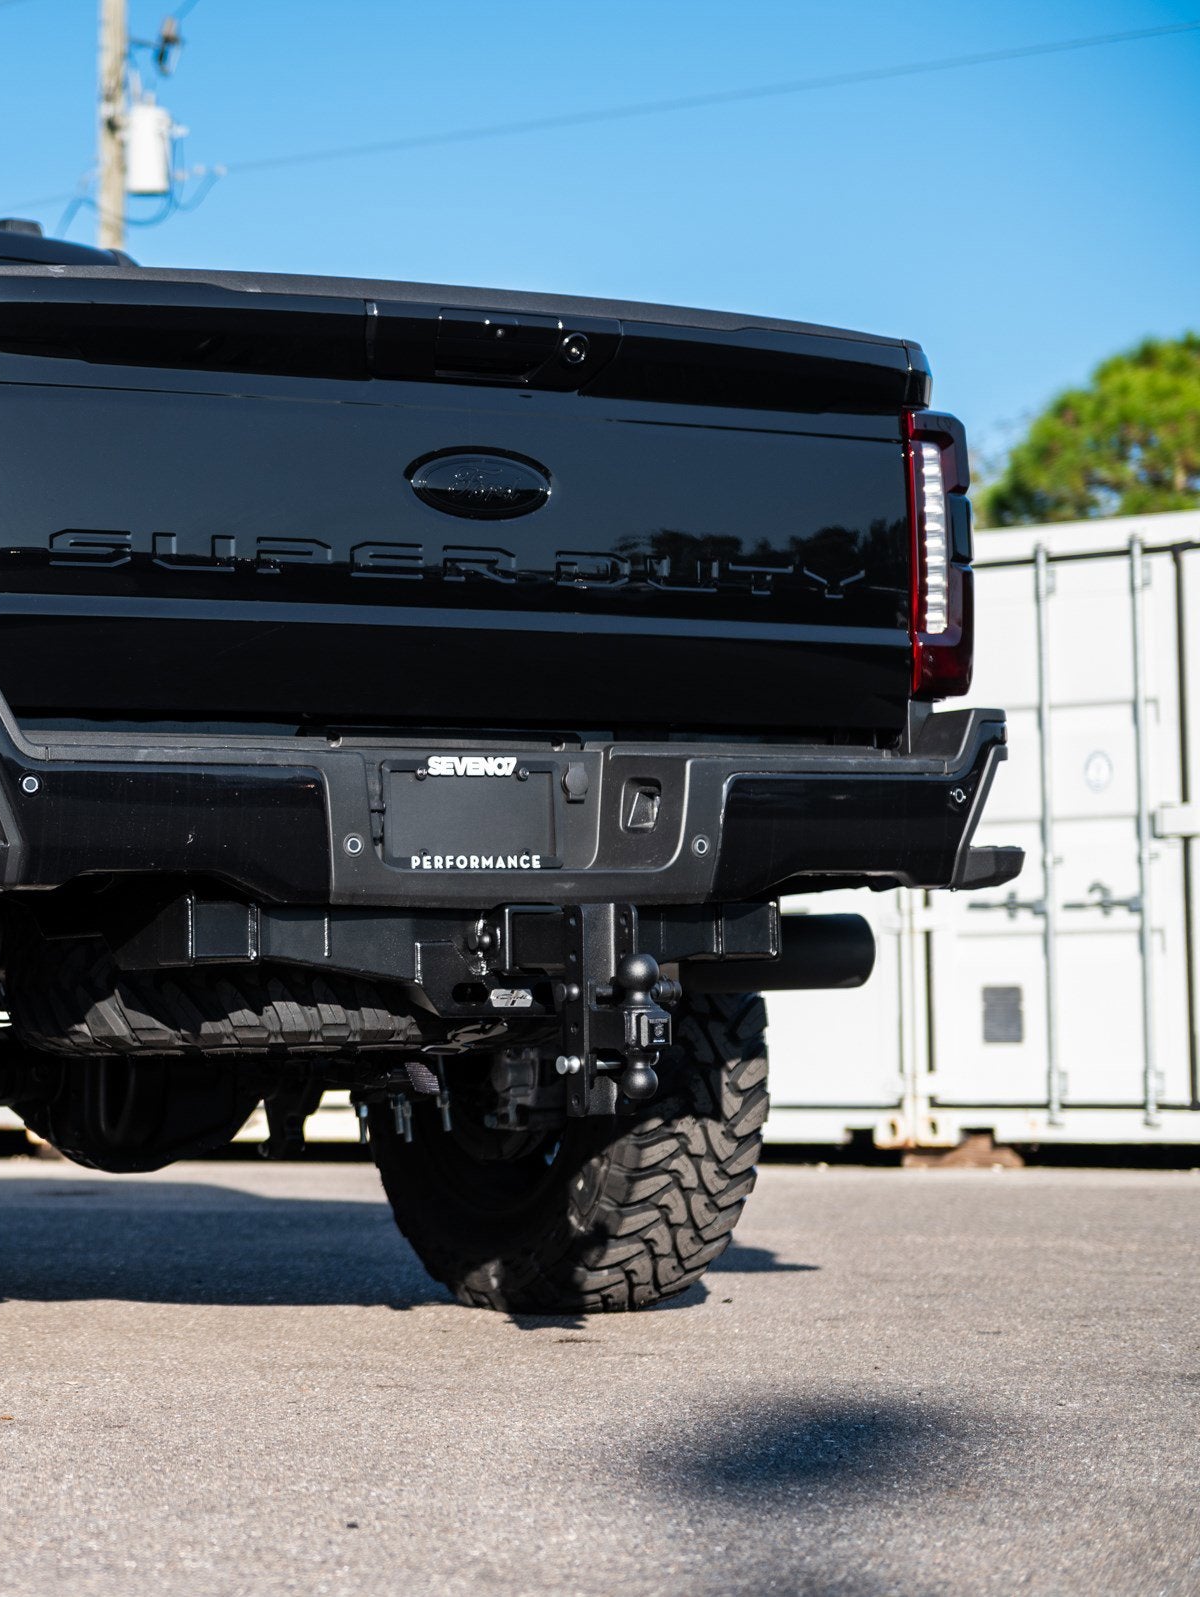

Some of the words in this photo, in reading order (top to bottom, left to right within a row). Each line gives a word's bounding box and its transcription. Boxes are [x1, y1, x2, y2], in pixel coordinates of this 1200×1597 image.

[49, 528, 517, 584] SUPER
[555, 550, 866, 599] DUTY
[410, 854, 542, 870] PERFORMANCE
